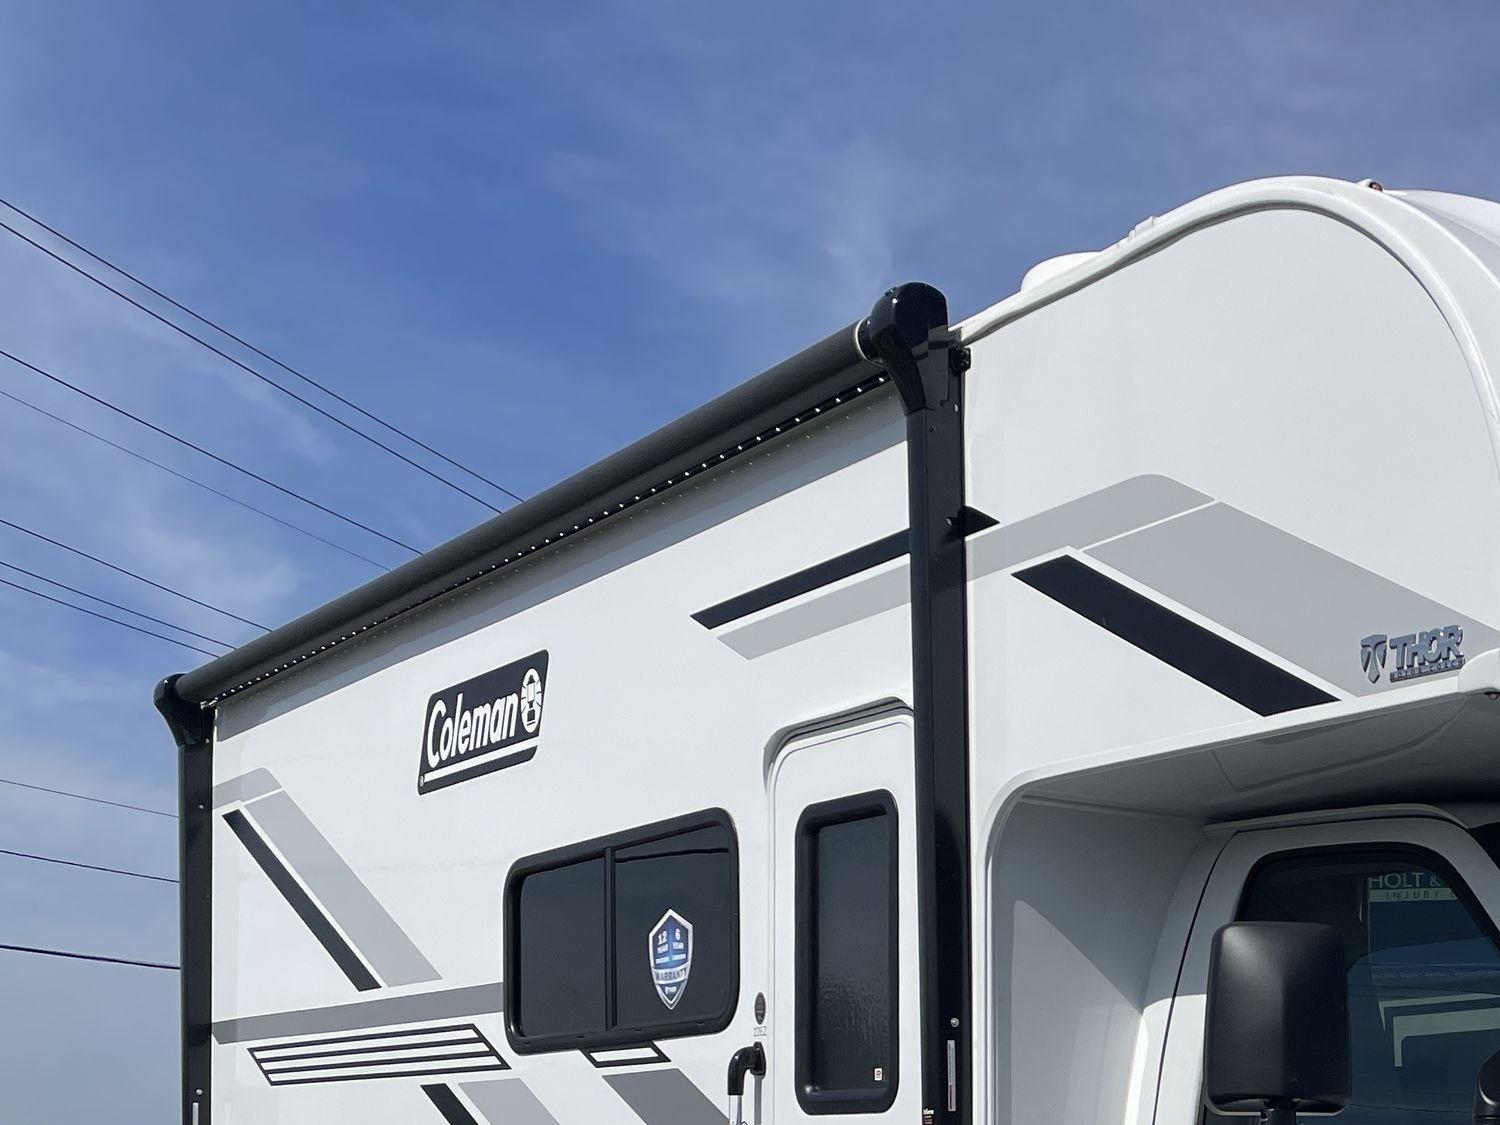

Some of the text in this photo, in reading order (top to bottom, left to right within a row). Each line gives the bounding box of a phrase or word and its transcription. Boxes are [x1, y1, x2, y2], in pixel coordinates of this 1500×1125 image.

[1389, 625, 1464, 670] THOR
[426, 692, 519, 769] Coleman
[1368, 872, 1423, 888] HOLT
[1386, 889, 1441, 901] INJURY
[655, 968, 688, 982] WARRANTY
